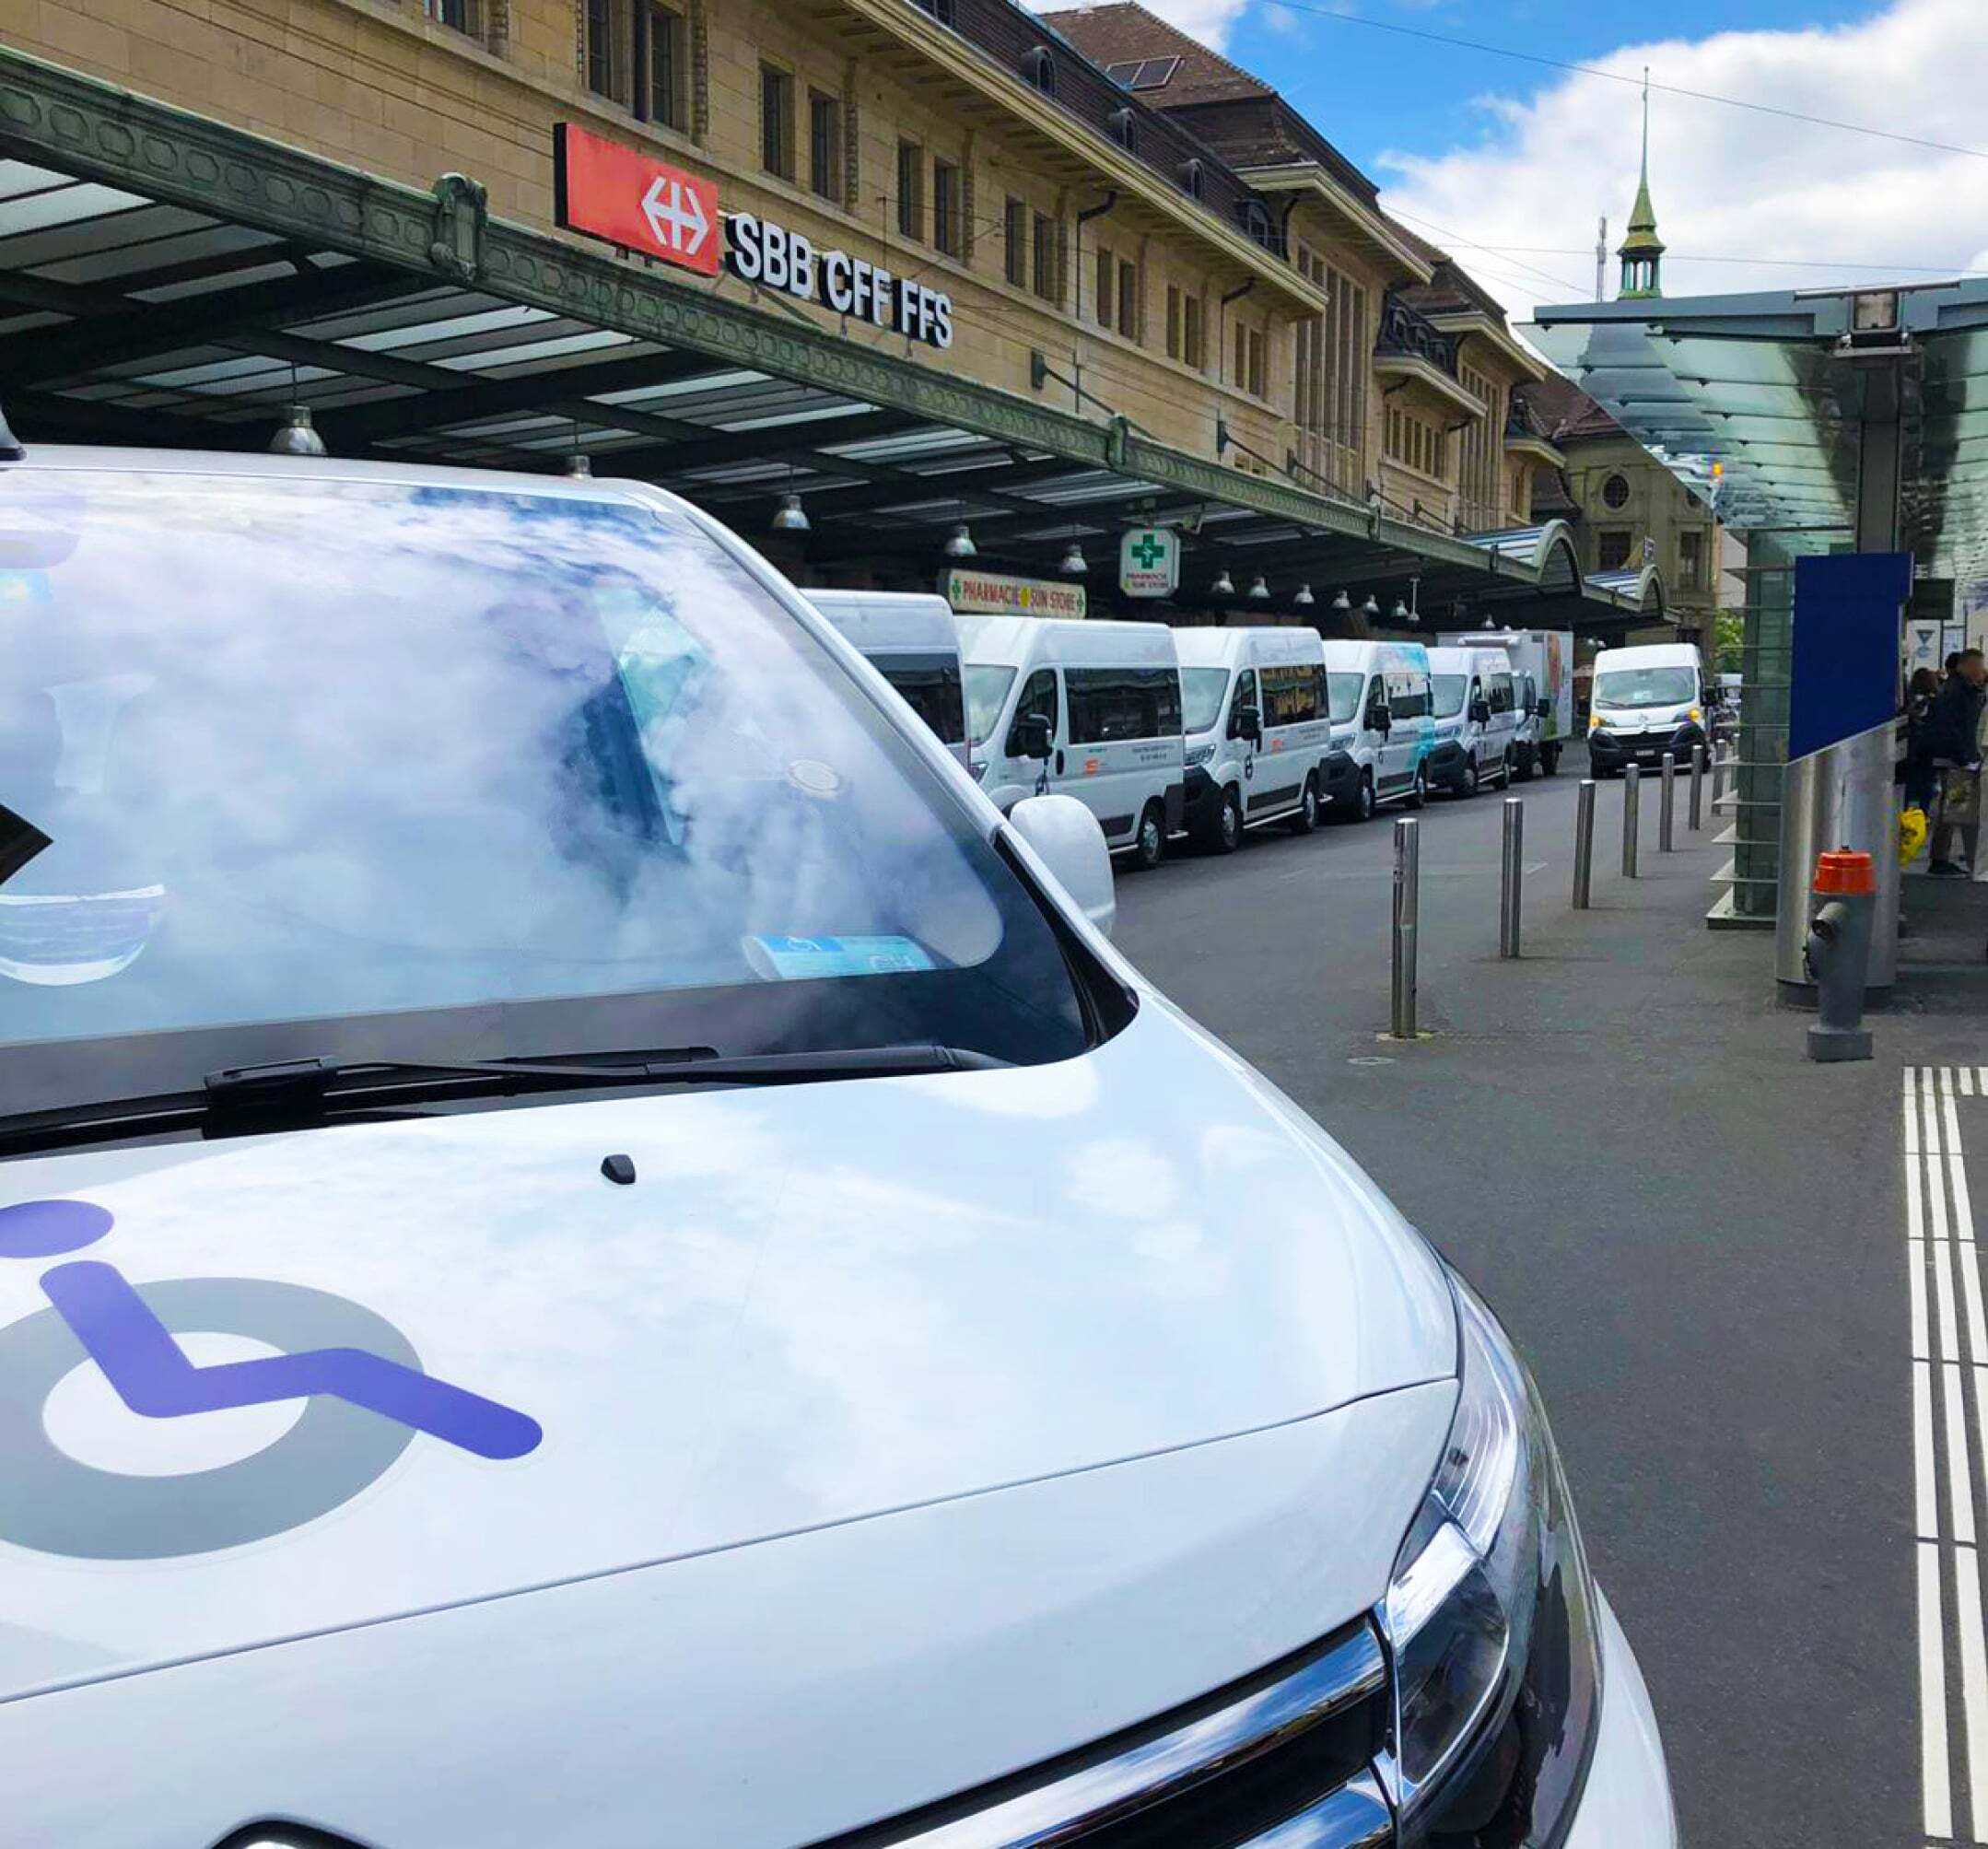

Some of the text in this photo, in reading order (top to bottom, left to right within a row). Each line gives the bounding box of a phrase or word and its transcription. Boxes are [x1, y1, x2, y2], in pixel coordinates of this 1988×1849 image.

[733, 212, 953, 348] SBB CFF FFS
[1031, 588, 1047, 606] SUN
[1049, 591, 1076, 611] STORE
